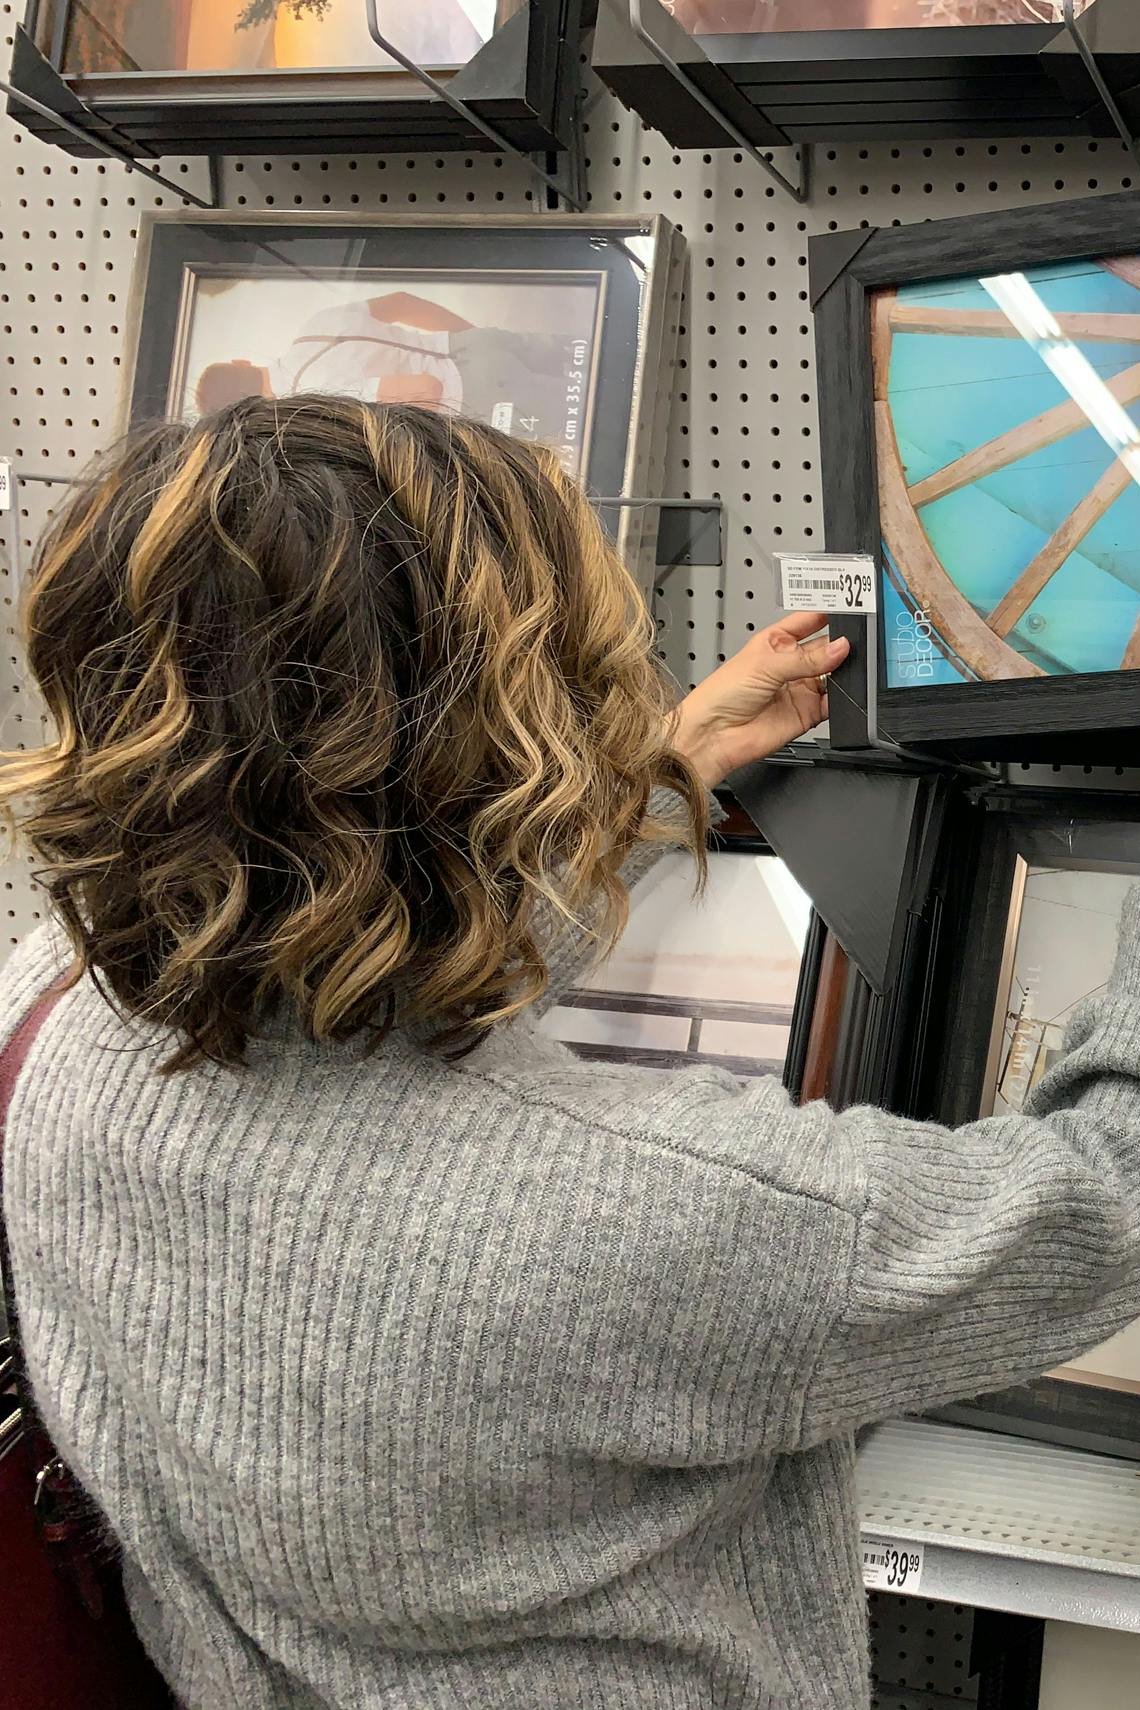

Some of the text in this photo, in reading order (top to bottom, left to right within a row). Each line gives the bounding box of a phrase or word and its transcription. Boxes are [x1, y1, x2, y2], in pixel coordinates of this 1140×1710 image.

[571, 339, 588, 366] cm)
[565, 370, 582, 403] 35.5
[565, 420, 578, 440] cm
[895, 611, 917, 679] STUDIO
